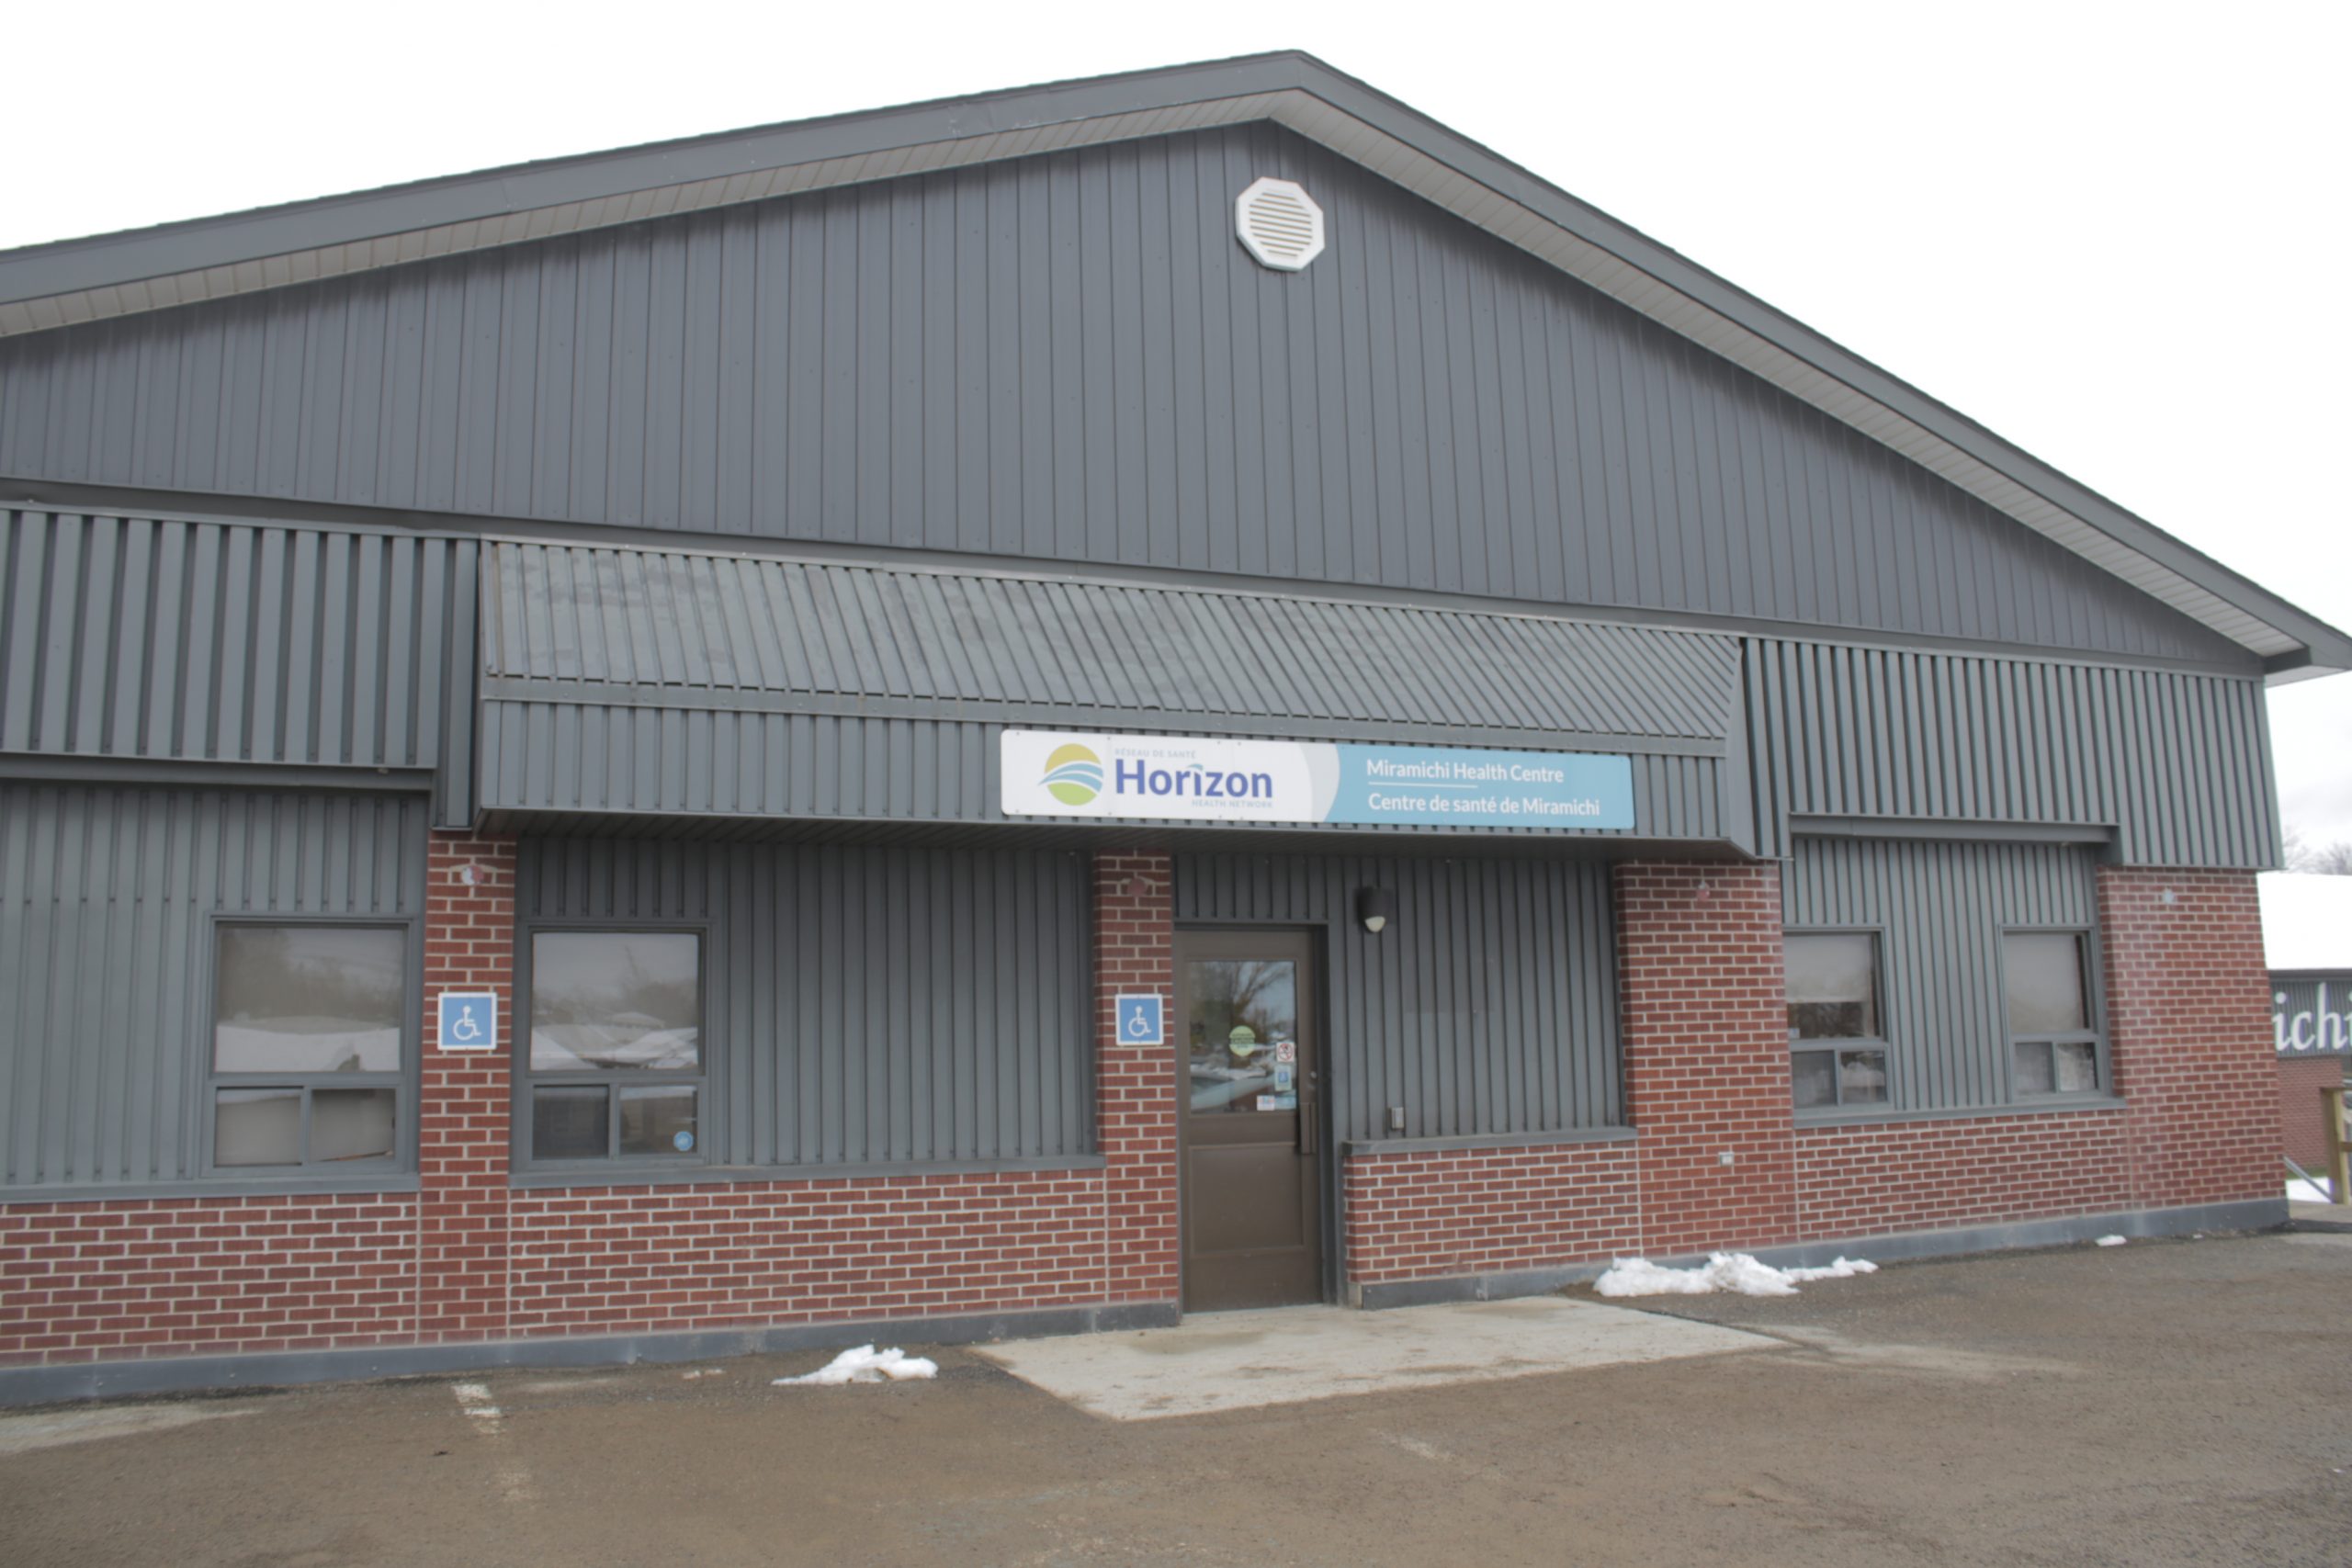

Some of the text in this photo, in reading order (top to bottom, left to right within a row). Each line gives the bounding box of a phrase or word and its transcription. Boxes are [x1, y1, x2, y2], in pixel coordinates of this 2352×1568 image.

[1152, 750, 1164, 758] DE
[1115, 759, 1273, 798] Horizon
[1366, 758, 1565, 783] Miramichi Health Centre
[1192, 799, 1273, 808] HEALTH NETWORK
[1368, 793, 1600, 816] Centre de santé de Miramichi
